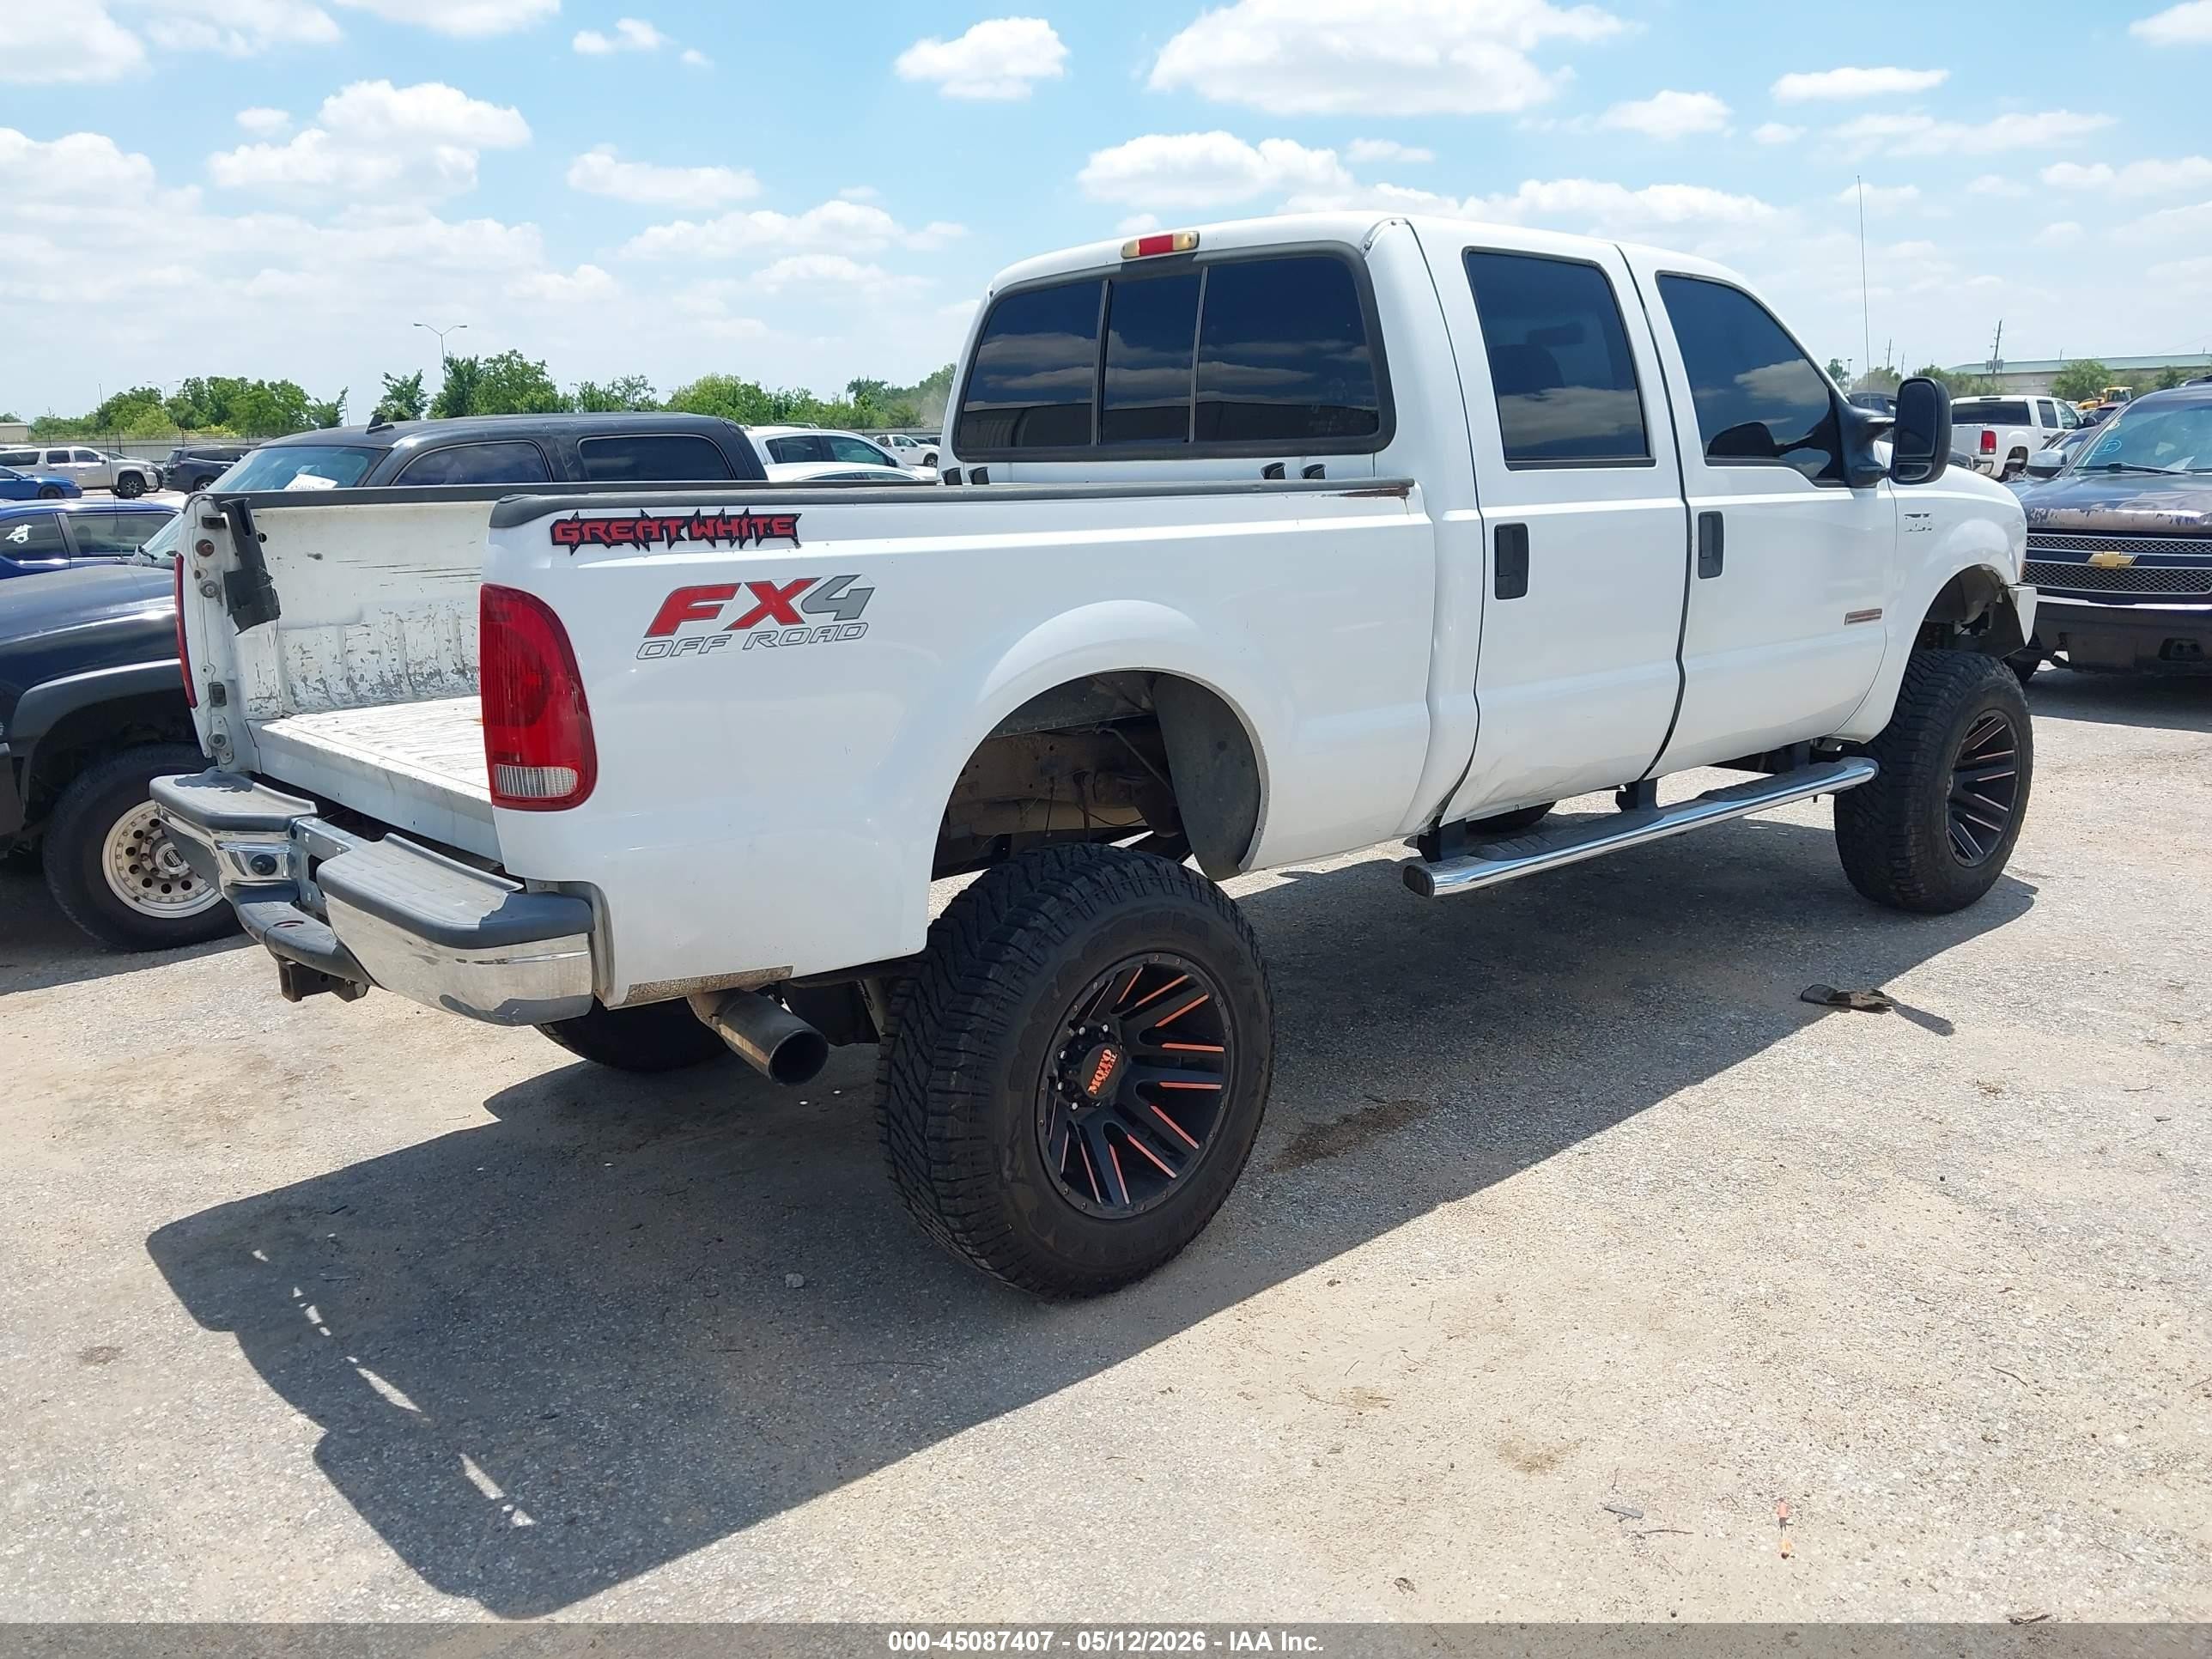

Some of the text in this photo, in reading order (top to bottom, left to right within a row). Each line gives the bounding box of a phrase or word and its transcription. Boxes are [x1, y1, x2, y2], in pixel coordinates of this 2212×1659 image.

[550, 510, 801, 553] GREAT WHITE
[644, 574, 876, 638] FX4
[635, 622, 868, 660] OFF ROAD
[1087, 1049, 1112, 1094] MOTO
